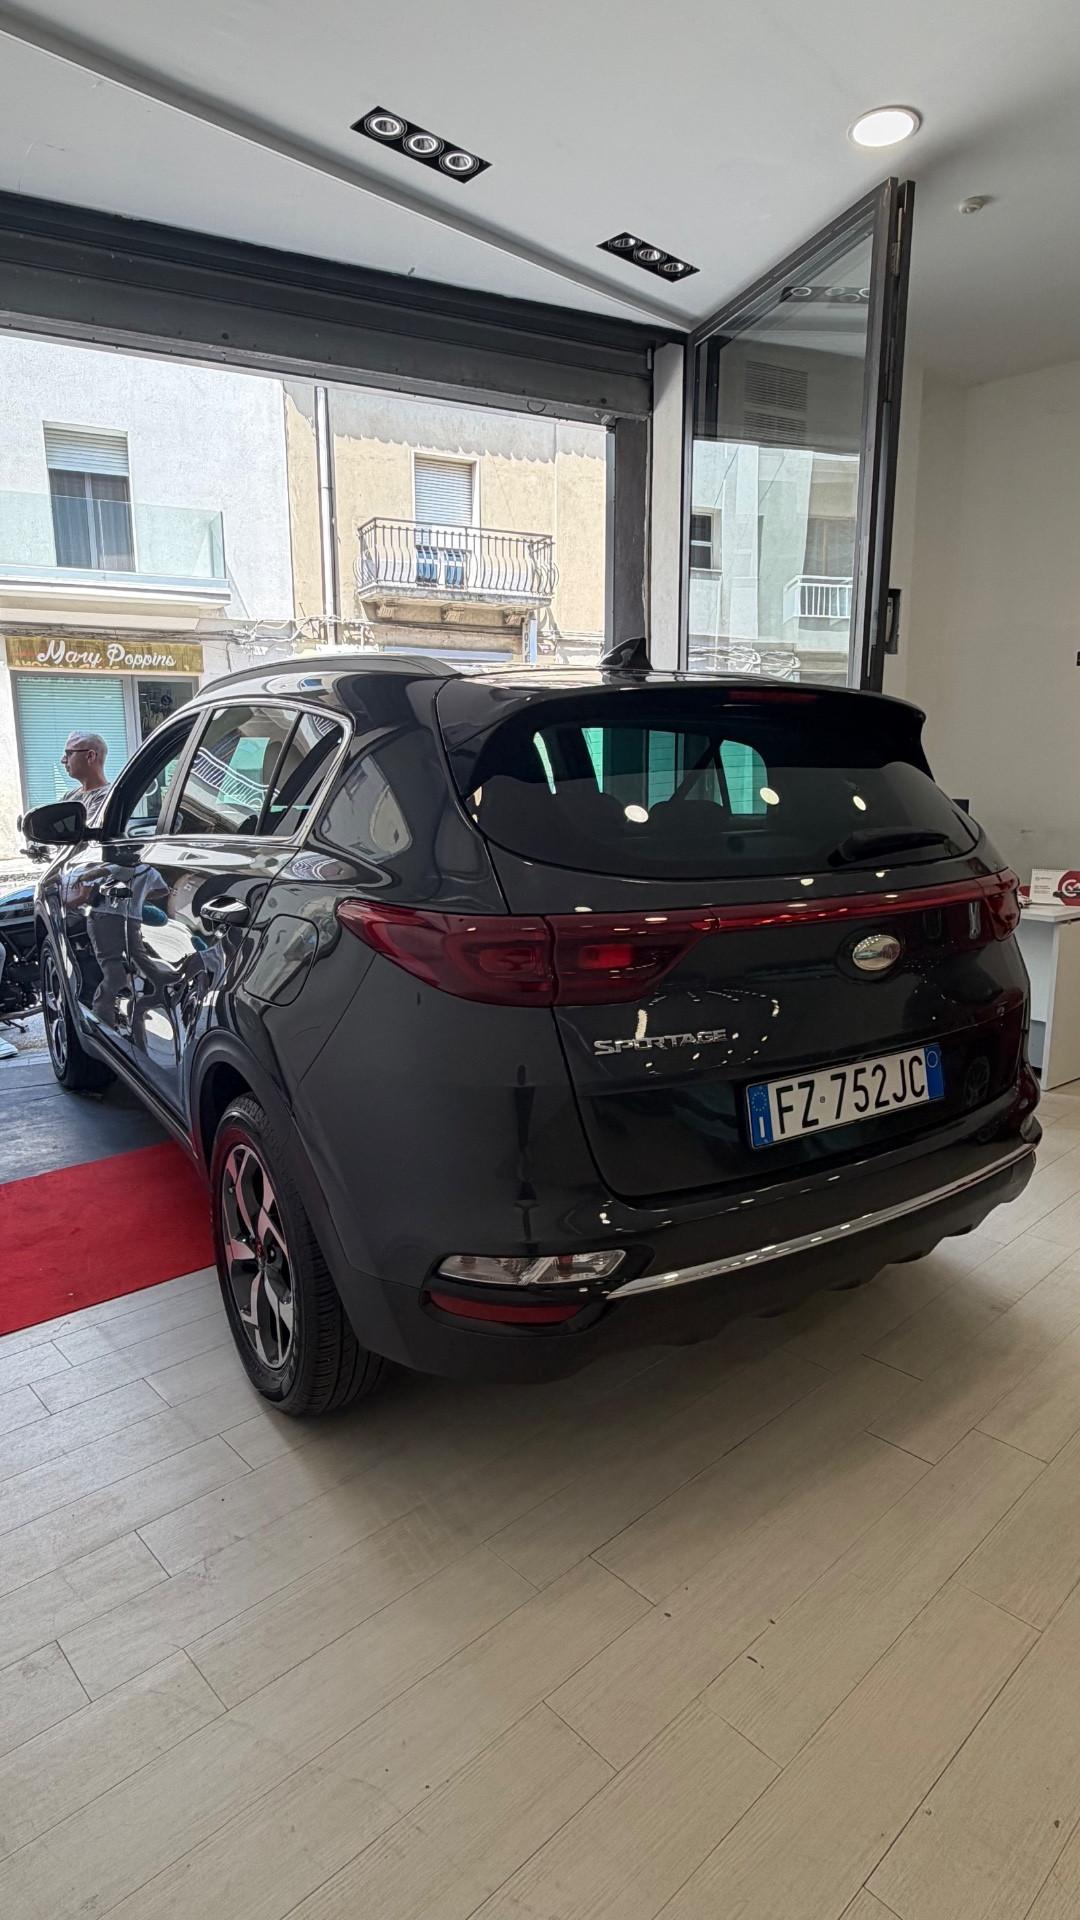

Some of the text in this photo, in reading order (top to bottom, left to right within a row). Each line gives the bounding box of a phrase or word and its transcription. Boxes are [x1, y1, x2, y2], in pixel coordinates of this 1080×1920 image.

[37, 639, 103, 664] Mary
[106, 643, 177, 669] Poppins
[593, 1028, 728, 1056] SPORTAGE
